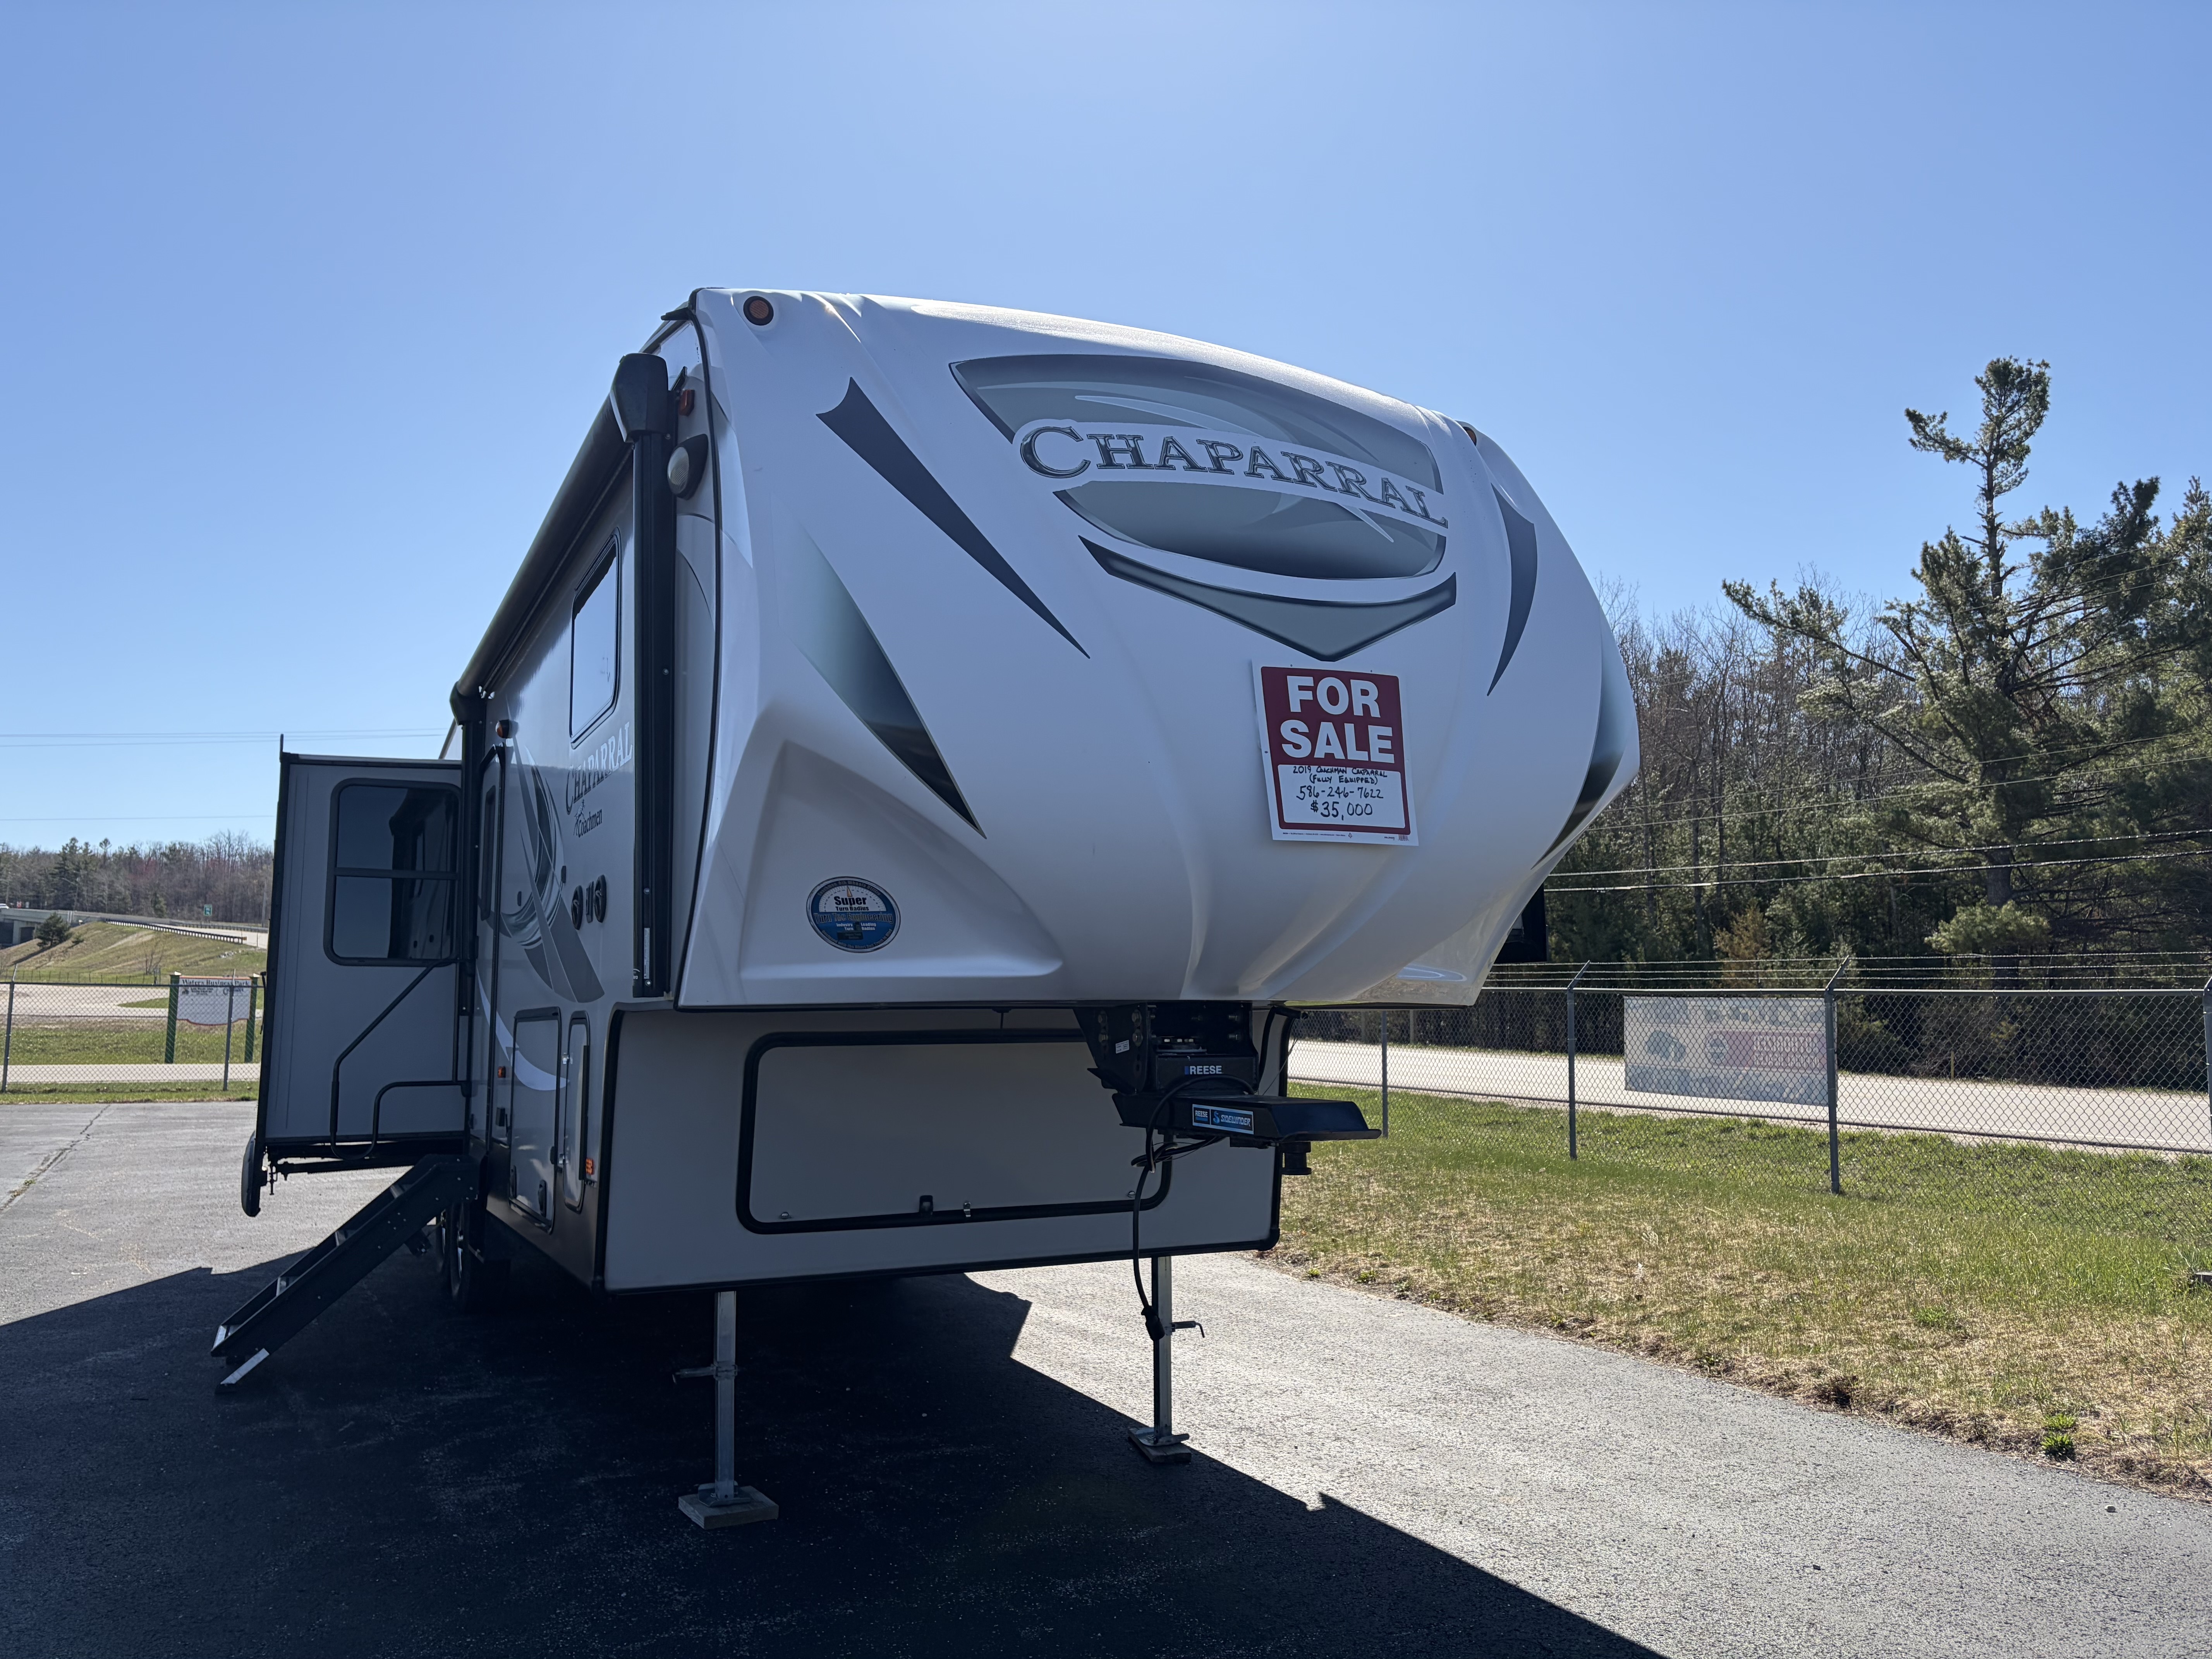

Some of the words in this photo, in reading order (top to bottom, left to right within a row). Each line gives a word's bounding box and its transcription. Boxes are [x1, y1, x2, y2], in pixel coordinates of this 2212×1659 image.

[1019, 425, 1448, 528] CHAPARRAL
[1286, 675, 1381, 718] FOR
[1280, 719, 1395, 763] SALE
[566, 721, 633, 815] CHAPARRAL
[1293, 766, 1312, 774] 2019
[1310, 800, 1373, 821] $35,000
[578, 809, 603, 838] Coachmen
[834, 896, 867, 906] Super
[1190, 1066, 1222, 1075] REESE
[1221, 1115, 1251, 1127] SIDEWINDER
